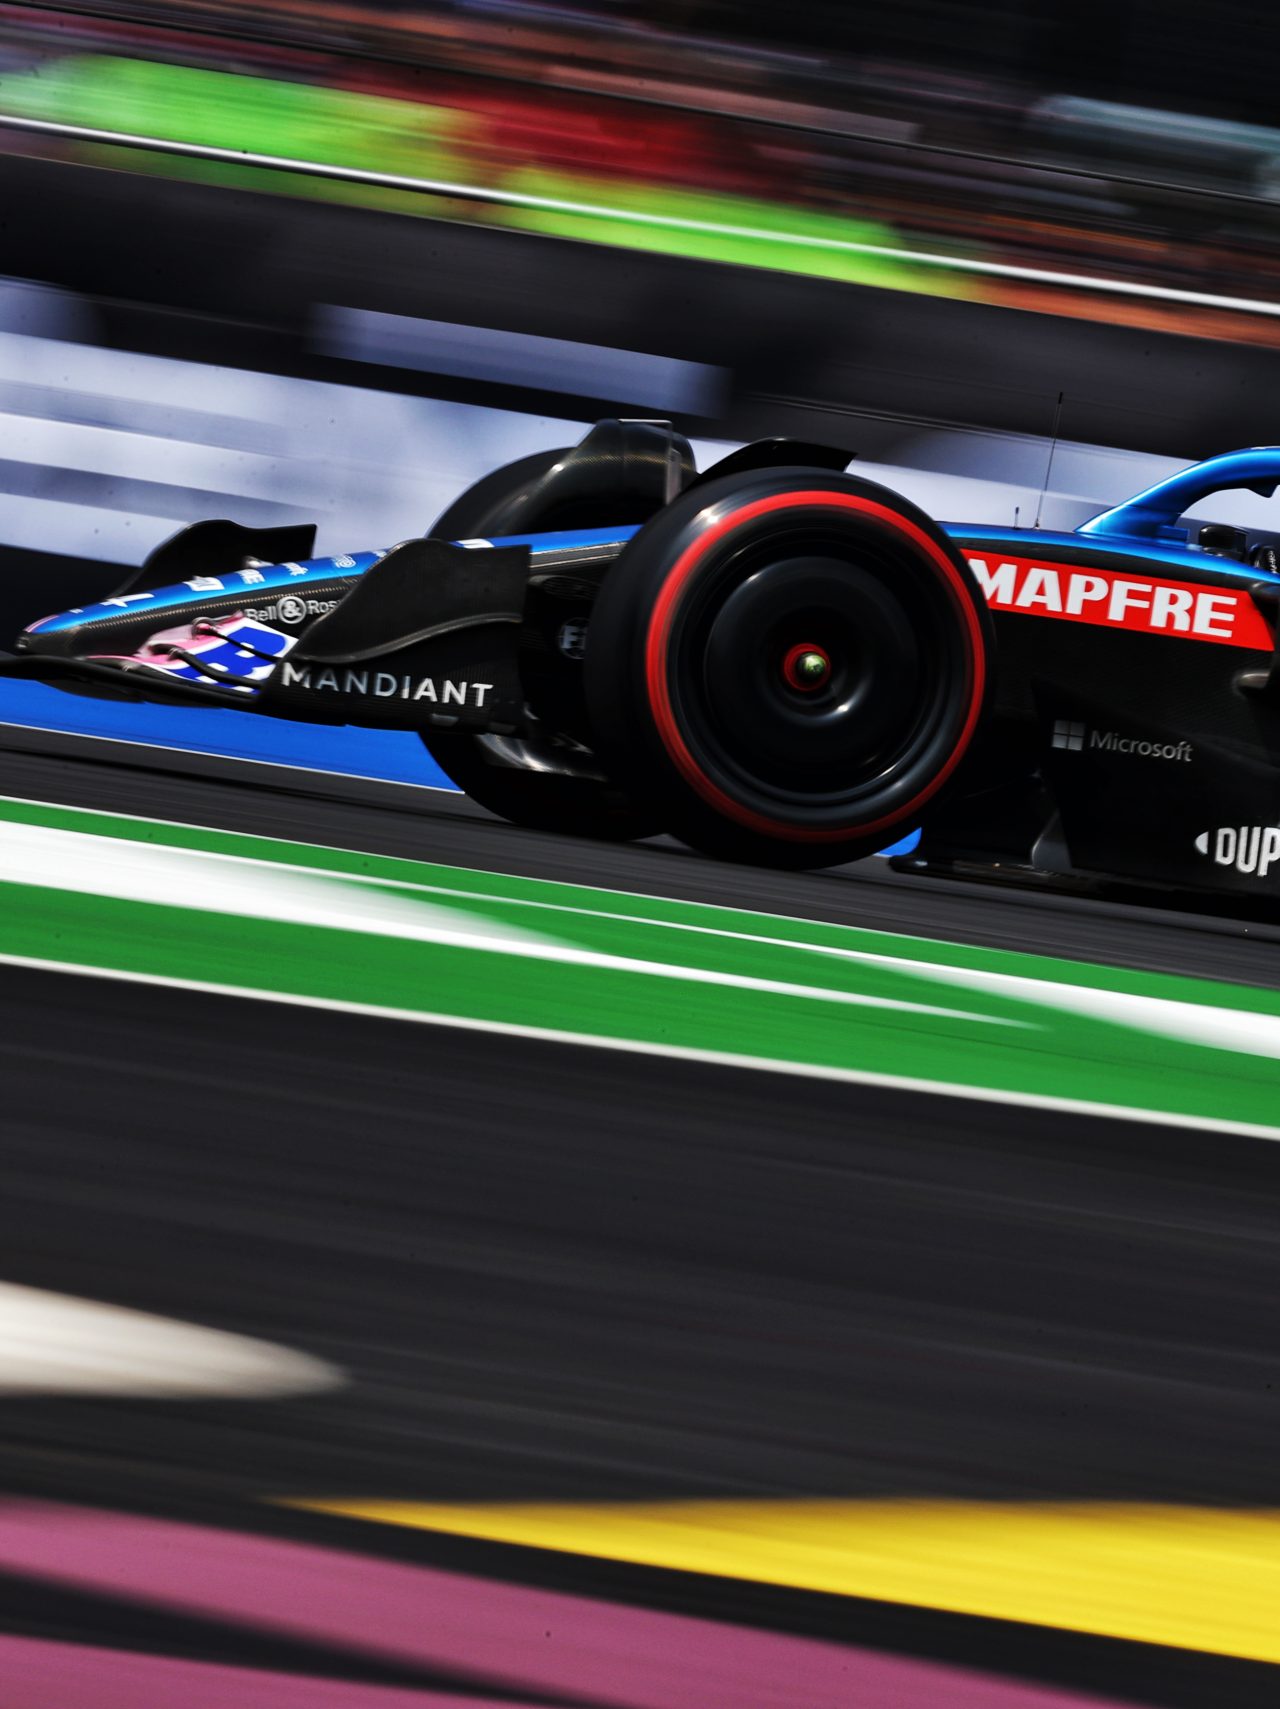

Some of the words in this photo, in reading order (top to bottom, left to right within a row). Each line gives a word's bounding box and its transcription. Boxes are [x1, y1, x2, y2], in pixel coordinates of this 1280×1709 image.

[245, 605, 277, 622] Bell
[308, 599, 343, 616] Ros
[968, 558, 1237, 638] MAPFRE
[281, 661, 494, 707] MANDIANT
[1090, 730, 1193, 762] Microsoft
